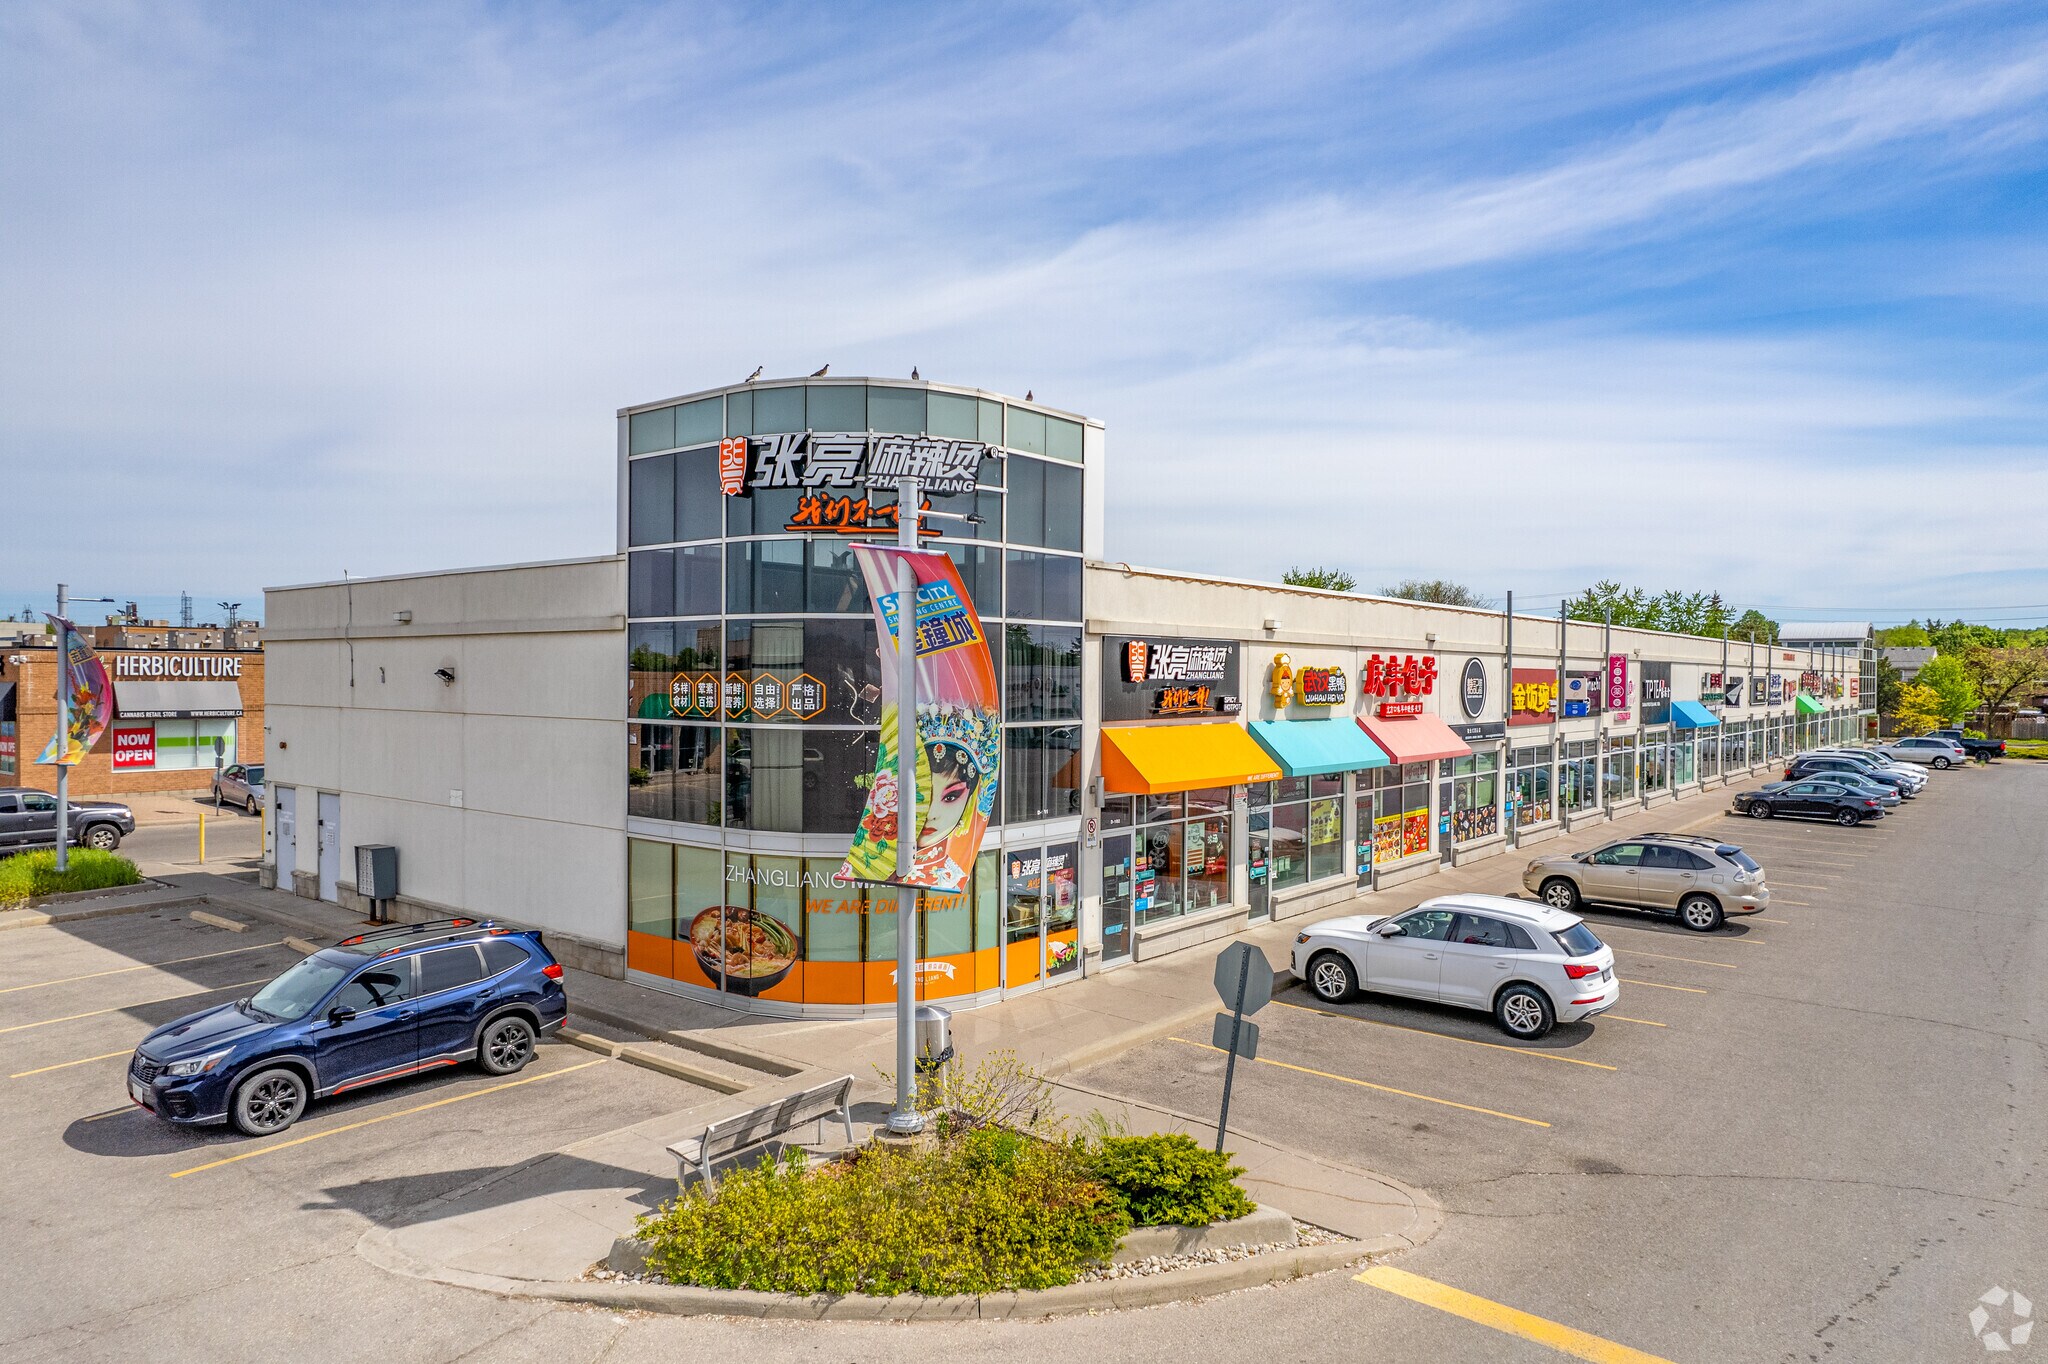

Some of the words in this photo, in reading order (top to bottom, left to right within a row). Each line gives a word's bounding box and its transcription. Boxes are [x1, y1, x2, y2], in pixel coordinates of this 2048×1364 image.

[752, 434, 985, 487] 张亮麻辣烫
[866, 475, 975, 493] ZHAGLIANG
[888, 606, 927, 624] SHNG
[929, 598, 959, 612] CENTRE
[894, 611, 977, 653] 鐘城
[116, 655, 242, 677] HERBICULTURE
[1149, 644, 1227, 680] 张亮麻辣烫
[1186, 671, 1224, 680] ZHANGLIANG
[1303, 670, 1345, 692] 武汉黑鸭
[1223, 696, 1238, 704] SPICY
[1223, 703, 1242, 711] HOTPOT
[117, 734, 150, 746] NOW
[115, 749, 153, 762] OPEN
[726, 864, 846, 889] ZHANGLIANG
[805, 898, 833, 914] WE
[836, 898, 870, 915] ARE
[875, 893, 968, 915] DIERENT!
